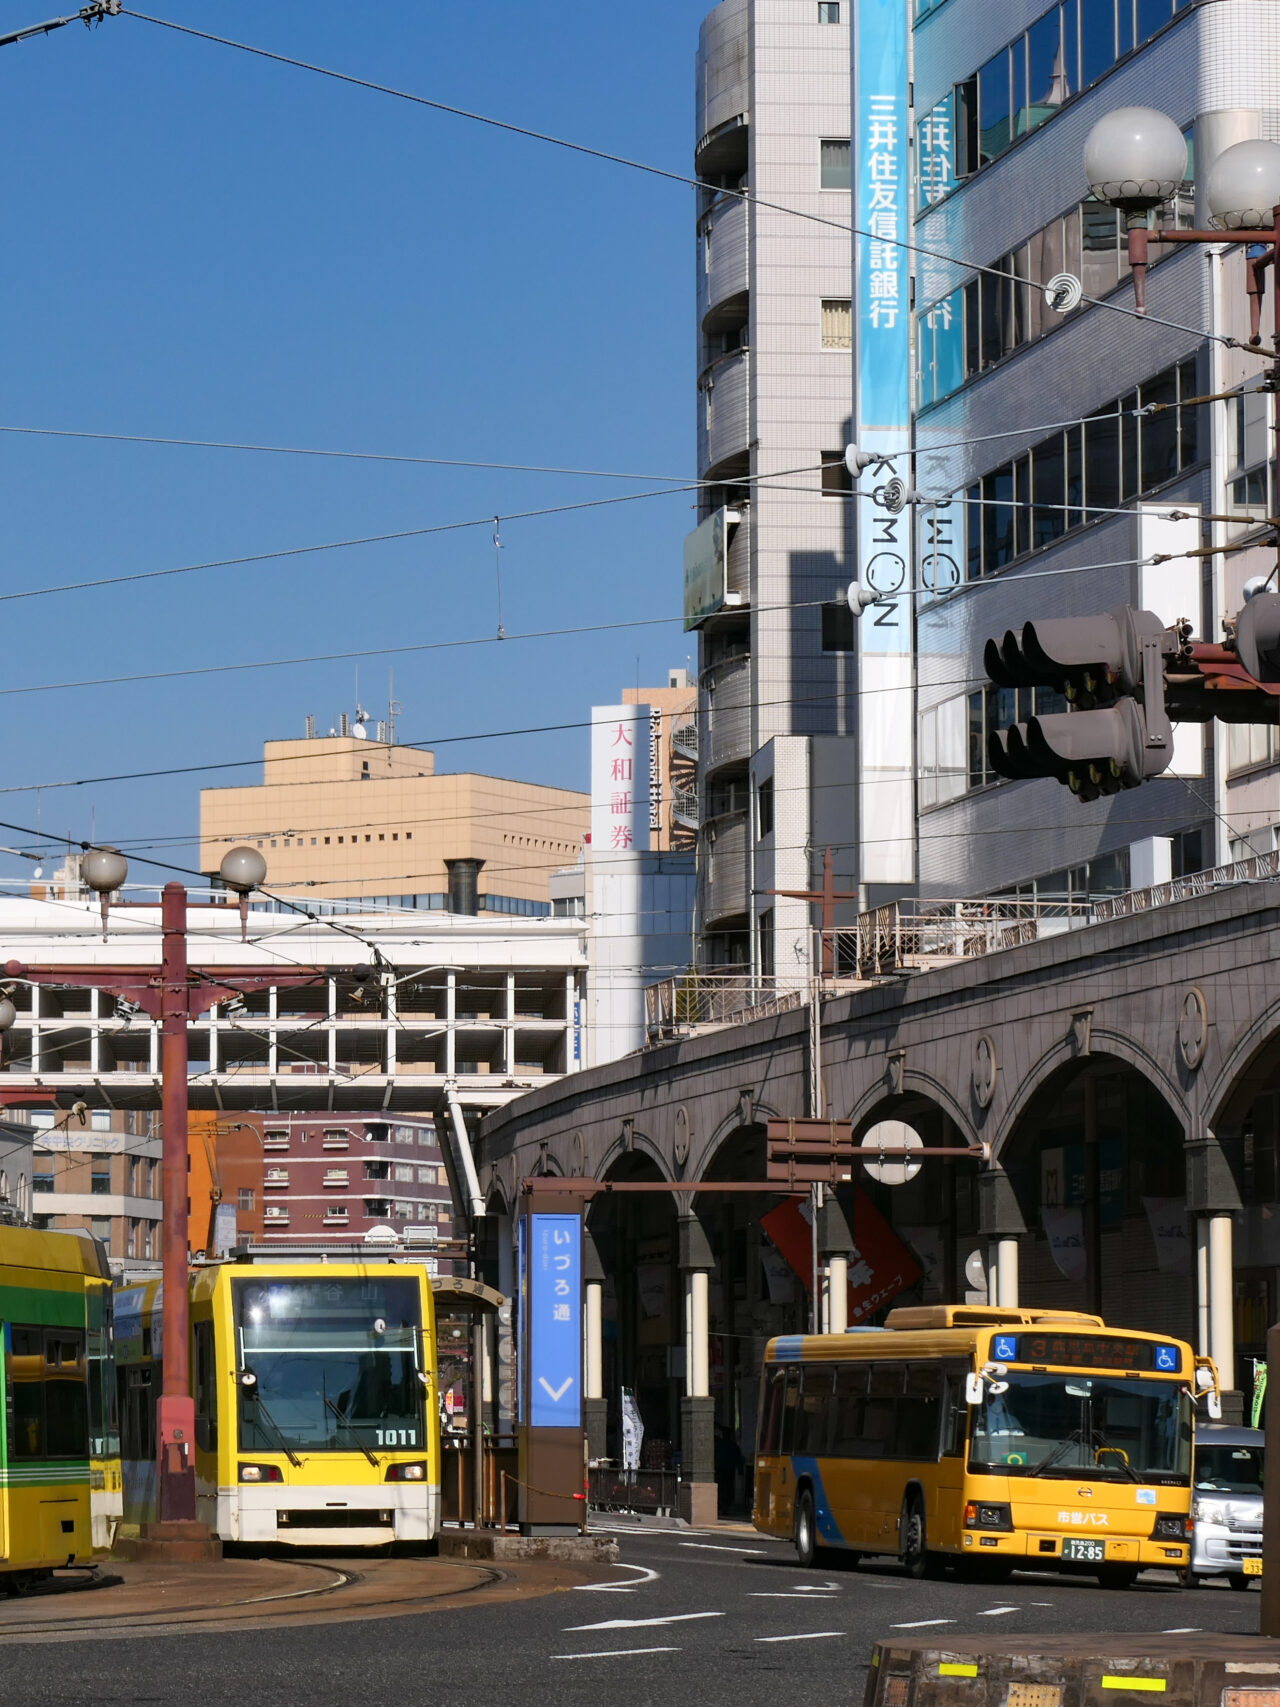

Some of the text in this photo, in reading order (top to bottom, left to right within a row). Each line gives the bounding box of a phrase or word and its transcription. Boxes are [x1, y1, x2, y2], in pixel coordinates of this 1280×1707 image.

[868, 95, 898, 329] 三井住友信託銀行
[610, 723, 633, 850] 大和証券
[650, 707, 662, 830] Richmond Hotel
[553, 1230, 571, 1321] いづろ通
[375, 1429, 417, 1446] 1011
[1057, 1511, 1109, 1527] 市営バス
